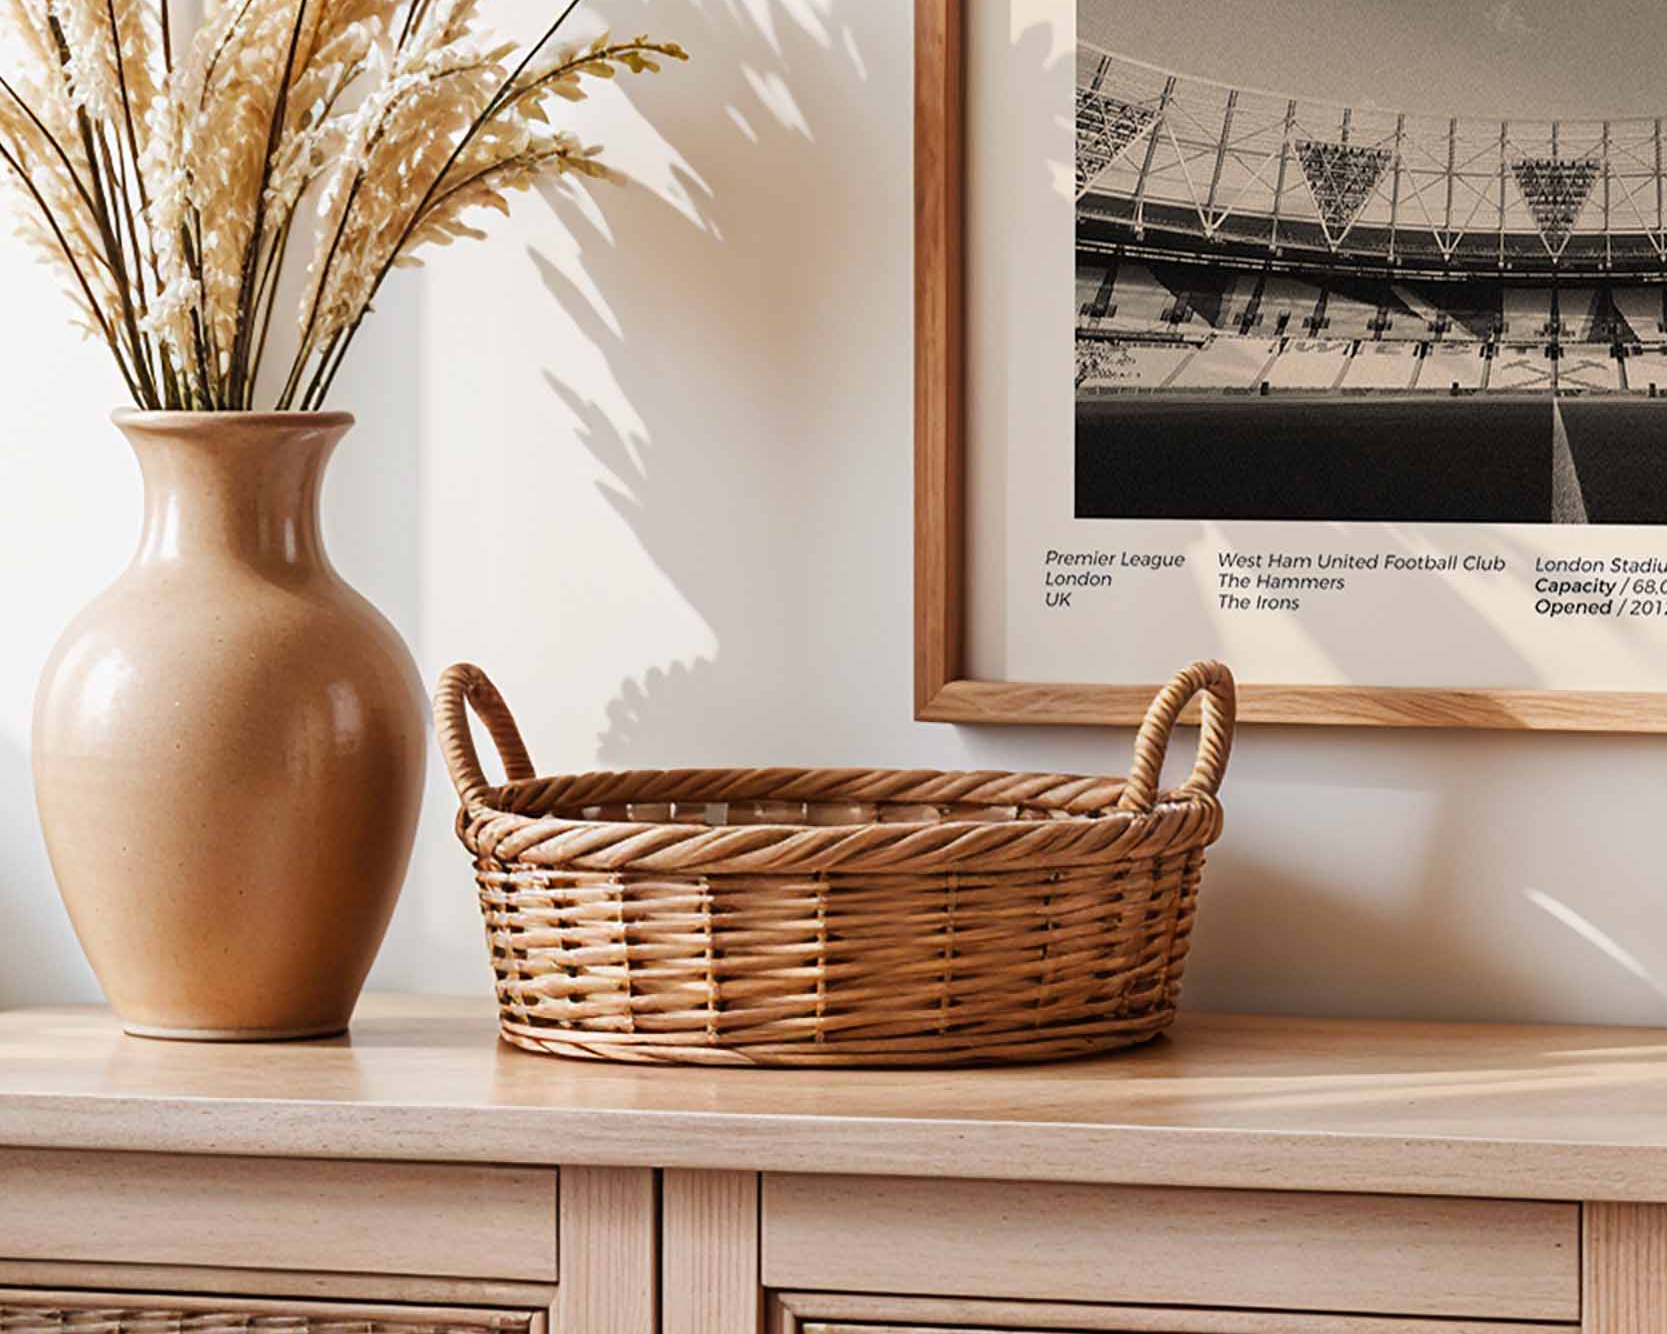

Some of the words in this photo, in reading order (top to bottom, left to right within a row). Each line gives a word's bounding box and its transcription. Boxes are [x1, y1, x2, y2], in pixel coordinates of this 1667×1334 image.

[1044, 549, 1117, 567] Premier
[1120, 551, 1186, 571] League
[1217, 552, 1263, 569] West
[1267, 553, 1313, 569] Ham
[1317, 553, 1380, 571] United
[1383, 553, 1458, 571] Football
[1462, 554, 1507, 573] Club
[1535, 556, 1605, 574] London
[1044, 570, 1113, 587] London
[1218, 572, 1252, 590] The
[1255, 573, 1345, 591] Hammers
[1534, 577, 1616, 598] Capacity
[1044, 591, 1073, 608] UK
[1218, 593, 1252, 611] The
[1255, 594, 1300, 611] Irons
[1534, 597, 1613, 619] Opened
